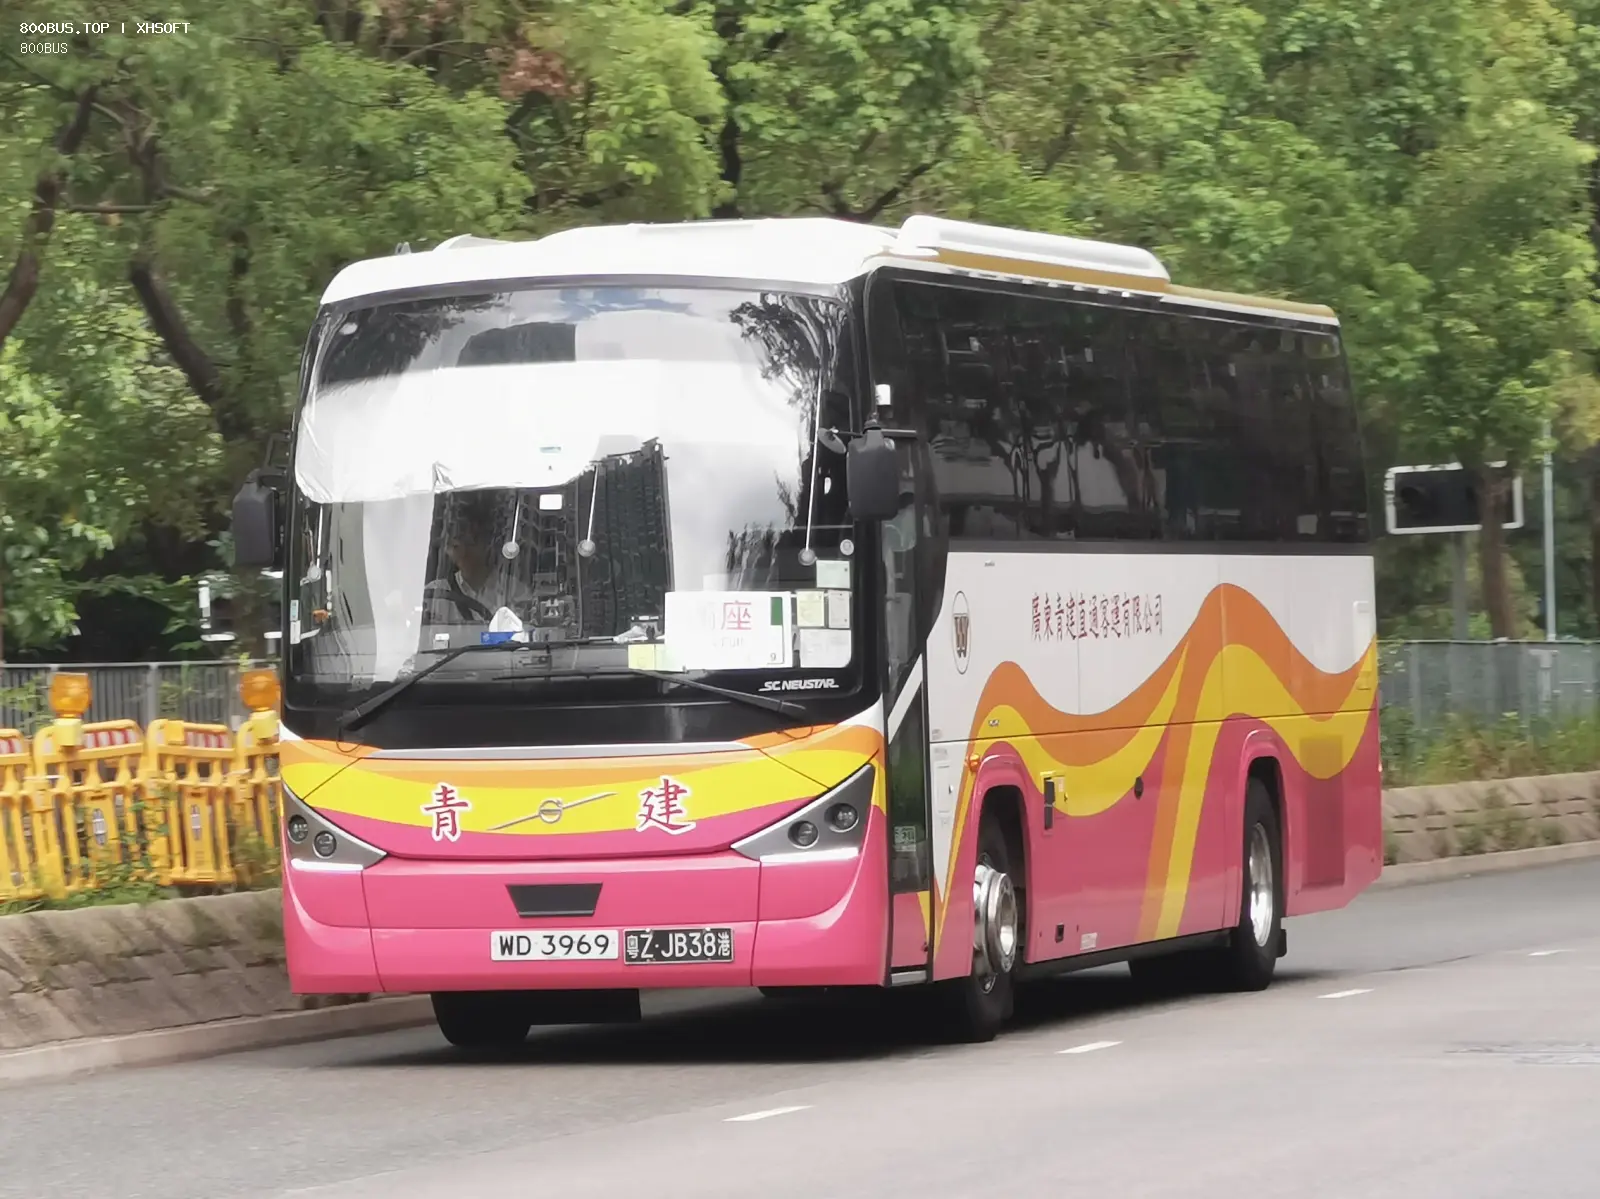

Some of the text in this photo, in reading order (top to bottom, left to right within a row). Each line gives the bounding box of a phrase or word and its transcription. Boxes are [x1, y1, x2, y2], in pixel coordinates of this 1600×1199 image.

[759, 678, 839, 692] SC NEUSTAR
[421, 776, 695, 841] 青 建
[499, 934, 610, 956] WD 3969
